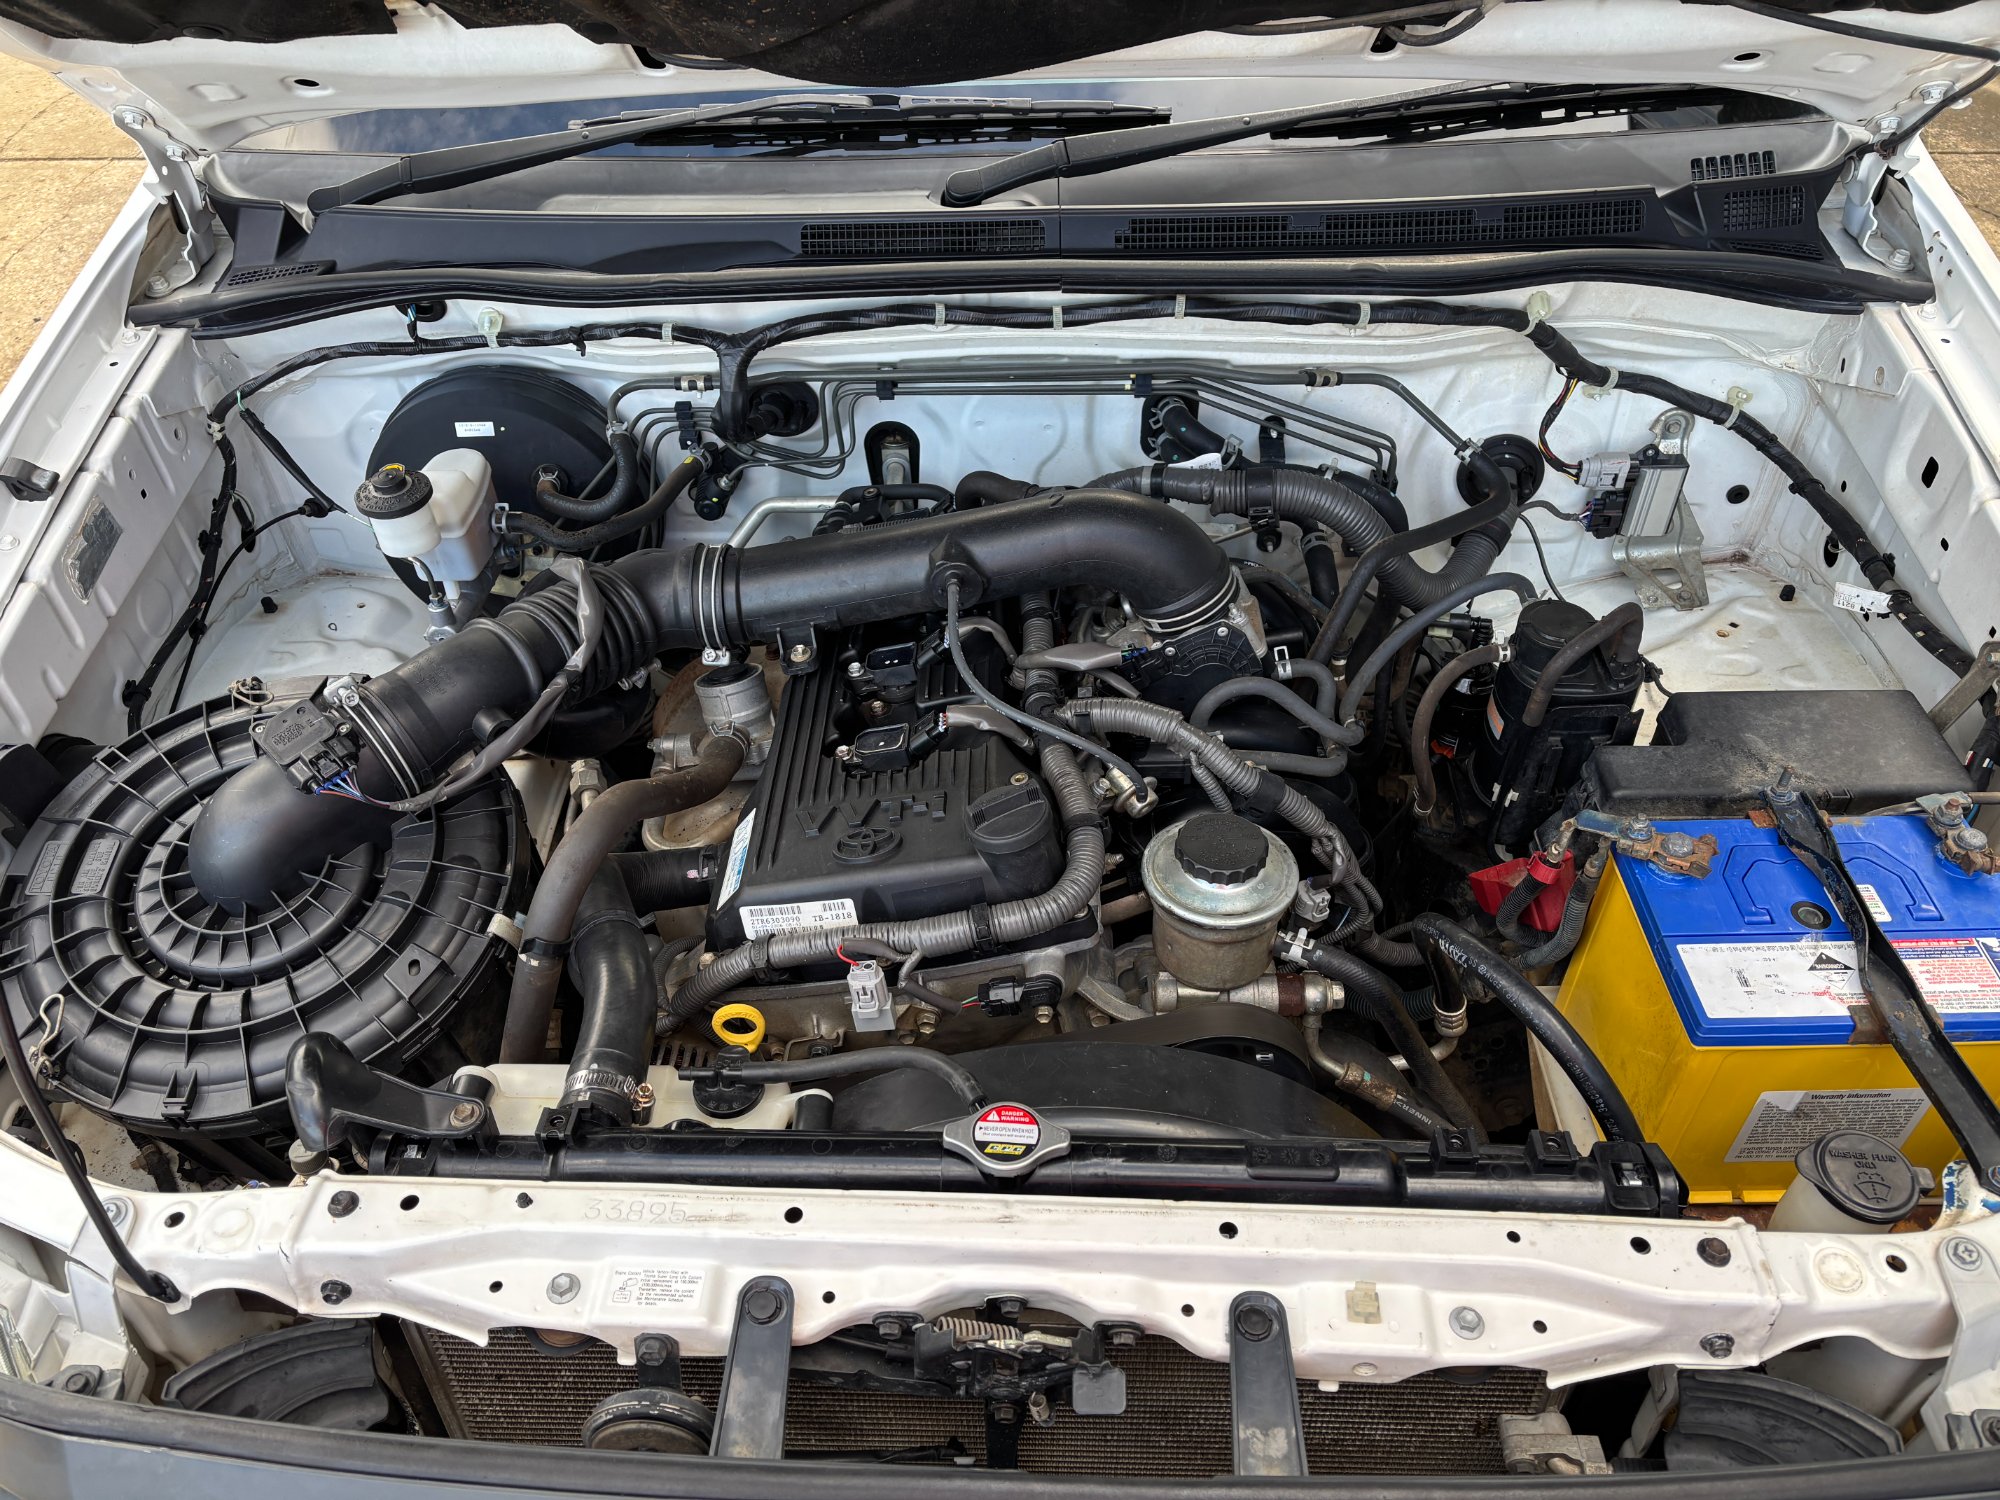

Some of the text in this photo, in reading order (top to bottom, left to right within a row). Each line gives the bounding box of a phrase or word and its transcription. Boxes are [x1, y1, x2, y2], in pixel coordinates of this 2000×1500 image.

[812, 912, 853, 922] TB-1818
[1811, 1093, 1845, 1101] Warranty
[1828, 1149, 1897, 1163] WASHER FLUID
[1854, 1161, 1877, 1170] ONLY
[584, 1199, 689, 1225] 33895
